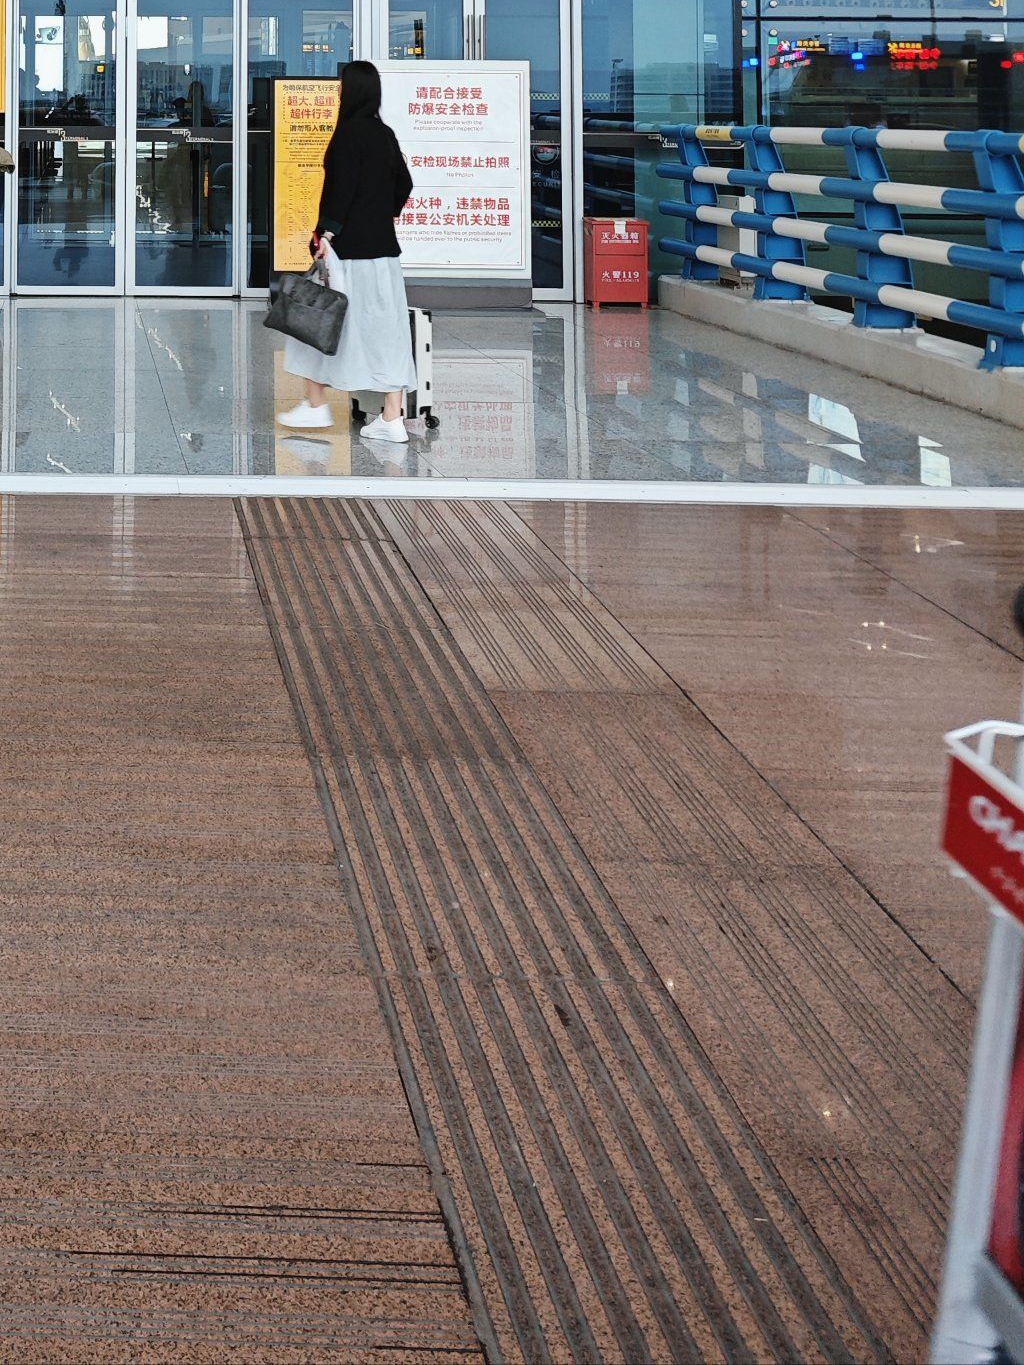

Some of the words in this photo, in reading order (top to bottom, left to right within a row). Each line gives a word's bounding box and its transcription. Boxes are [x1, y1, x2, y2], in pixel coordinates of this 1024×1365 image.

[415, 86, 483, 100] 请配合接受
[290, 108, 333, 120] 超件行李
[408, 103, 489, 116] 防爆安全检查
[411, 155, 511, 169] 安检现场禁止拍照
